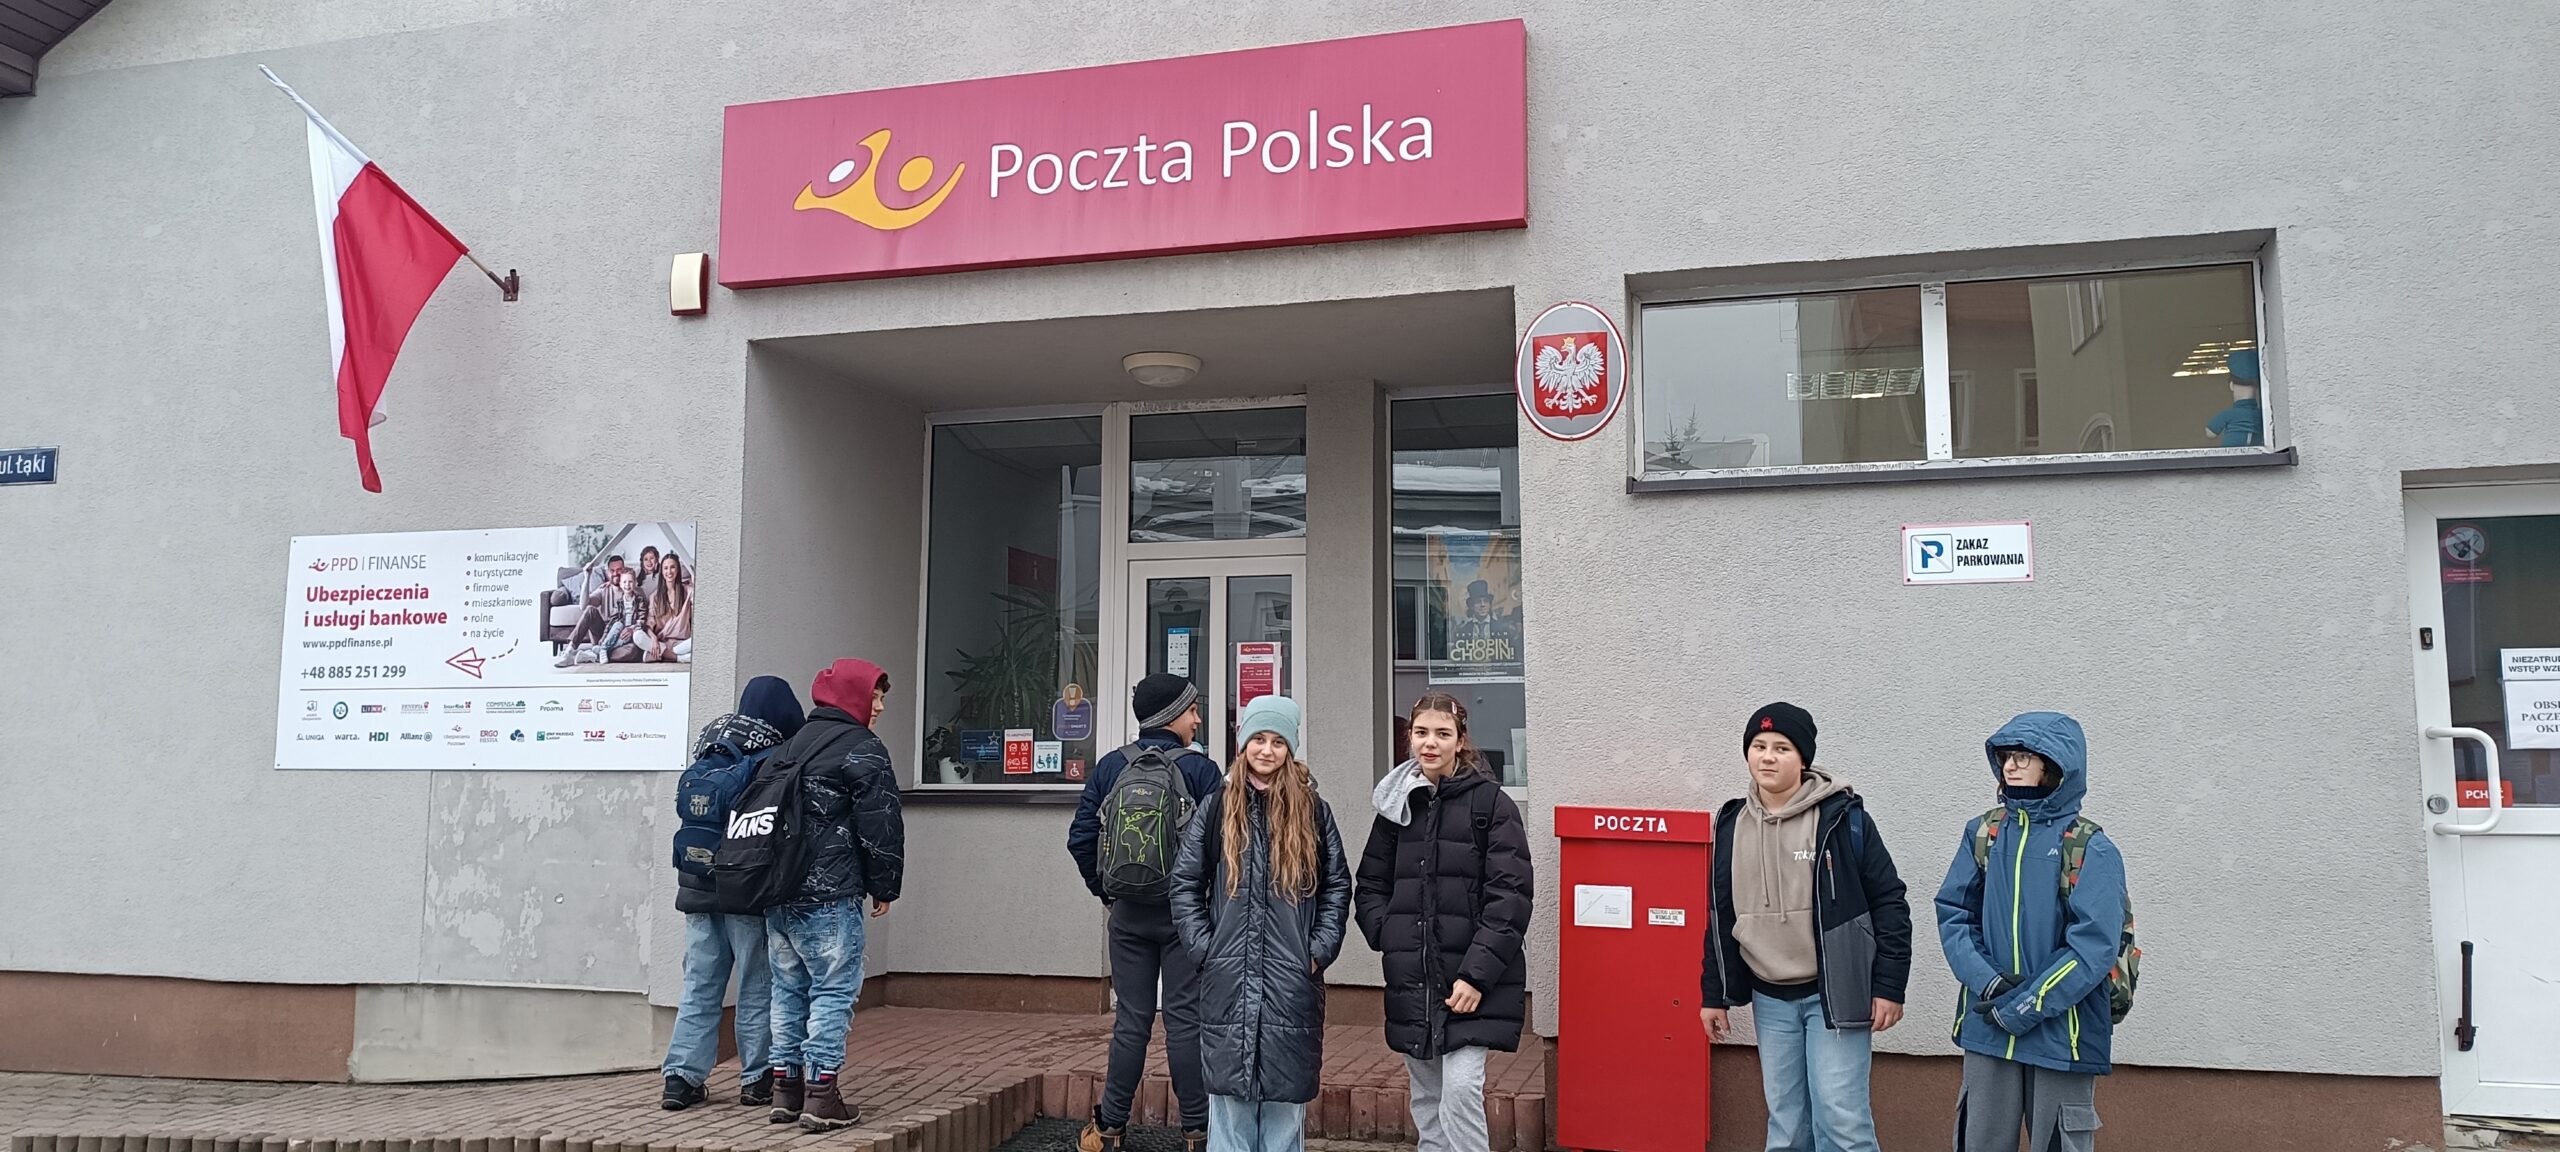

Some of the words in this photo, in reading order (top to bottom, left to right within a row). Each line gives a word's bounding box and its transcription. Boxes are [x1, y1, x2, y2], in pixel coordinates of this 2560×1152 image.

[989, 133, 1193, 198] Poczta
[1222, 103, 1434, 178] Polska
[15, 454, 47, 477] Łąki
[1956, 538, 1989, 551] ZAKAZ
[331, 557, 358, 571] PPD
[368, 554, 427, 570] FINANSE
[474, 551, 539, 563] komunikacyjne
[1957, 553, 2025, 567] PARKOWANIA
[473, 568, 523, 579] turystyczne
[473, 583, 510, 592] firmowe
[306, 583, 430, 606] Ubezpieczenia
[472, 597, 533, 607] mieszkaniowe
[304, 610, 310, 628] i
[313, 609, 366, 631] usługi
[369, 608, 448, 626] bankowe
[470, 613, 495, 622] rolne
[470, 630, 481, 638] na
[483, 627, 505, 639] życie
[302, 637, 393, 650] www.ppdfinanse.pl
[1455, 638, 1509, 651] CHOPIN
[1449, 647, 1515, 661] CHOPIN!
[2511, 655, 2560, 663] NIEZATRU
[301, 666, 326, 679] +48
[328, 665, 353, 679] 885
[355, 665, 379, 679] 251
[382, 665, 407, 678] 299
[2508, 665, 2541, 674] WSTĘP
[2533, 700, 2560, 709] OBS
[368, 731, 389, 742] HDI
[400, 732, 424, 741] Allianz
[480, 729, 499, 737] ERGO
[583, 730, 606, 738] TUZ
[726, 806, 778, 840] VANS
[1594, 815, 1668, 832] POCZTA
